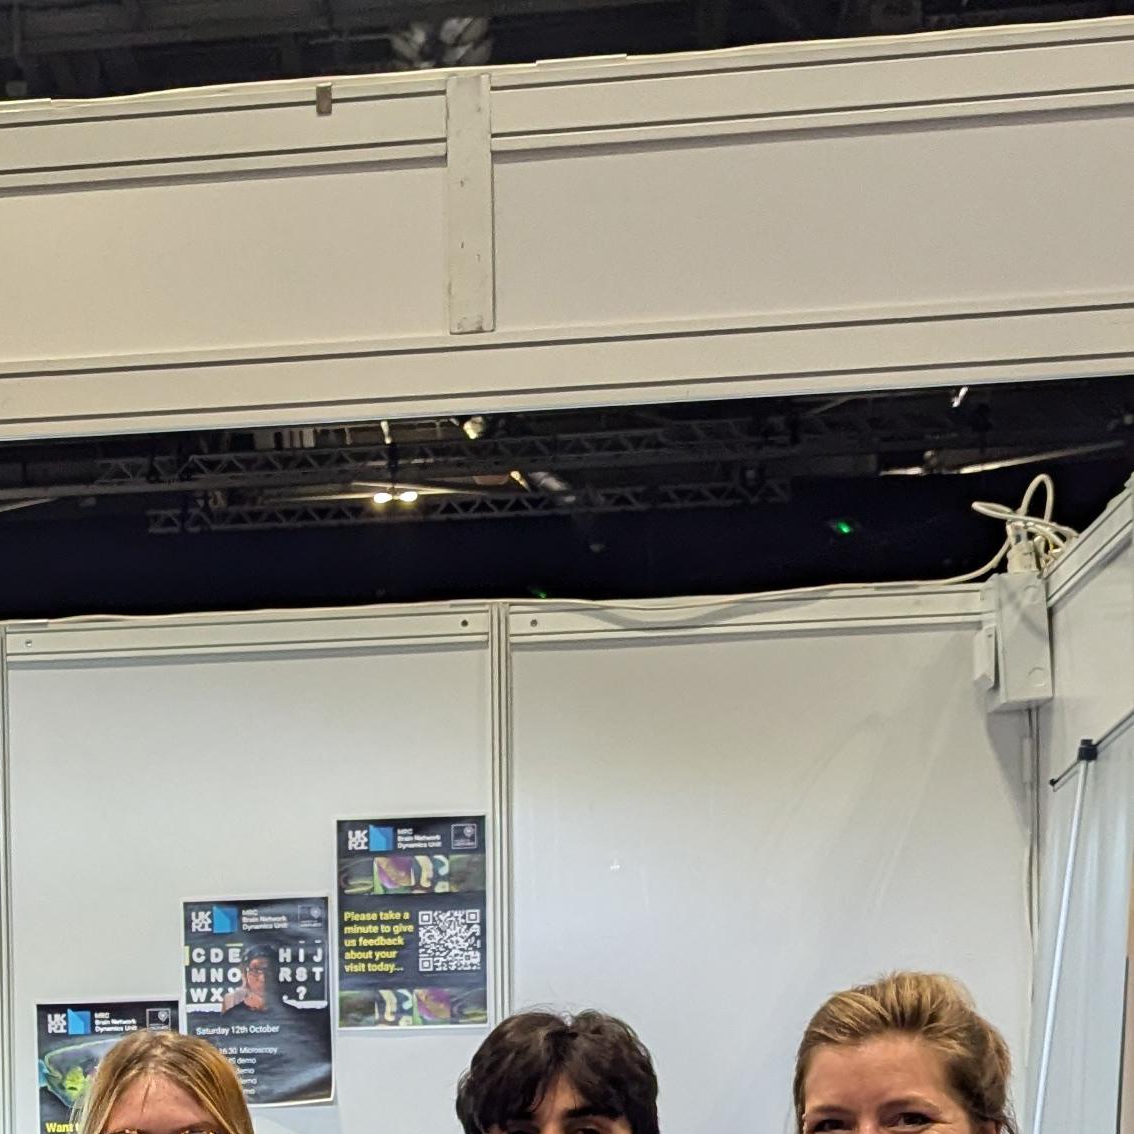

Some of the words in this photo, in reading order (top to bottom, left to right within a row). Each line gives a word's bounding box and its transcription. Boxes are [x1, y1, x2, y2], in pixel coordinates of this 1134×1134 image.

[343, 911, 378, 921] Please
[379, 910, 402, 920] take
[403, 911, 410, 920] a
[344, 924, 379, 934] minute
[380, 924, 391, 933] to
[392, 923, 414, 935] give
[344, 938, 356, 946] us
[358, 936, 404, 946] feedback
[344, 950, 373, 960] about
[374, 950, 398, 961] your
[344, 963, 366, 973] visit
[196, 1026, 229, 1036] Saturday
[231, 1025, 248, 1034] 12th
[249, 1024, 280, 1033] October
[239, 1046, 278, 1055] Microscopy
[45, 1122, 74, 1133] Want
